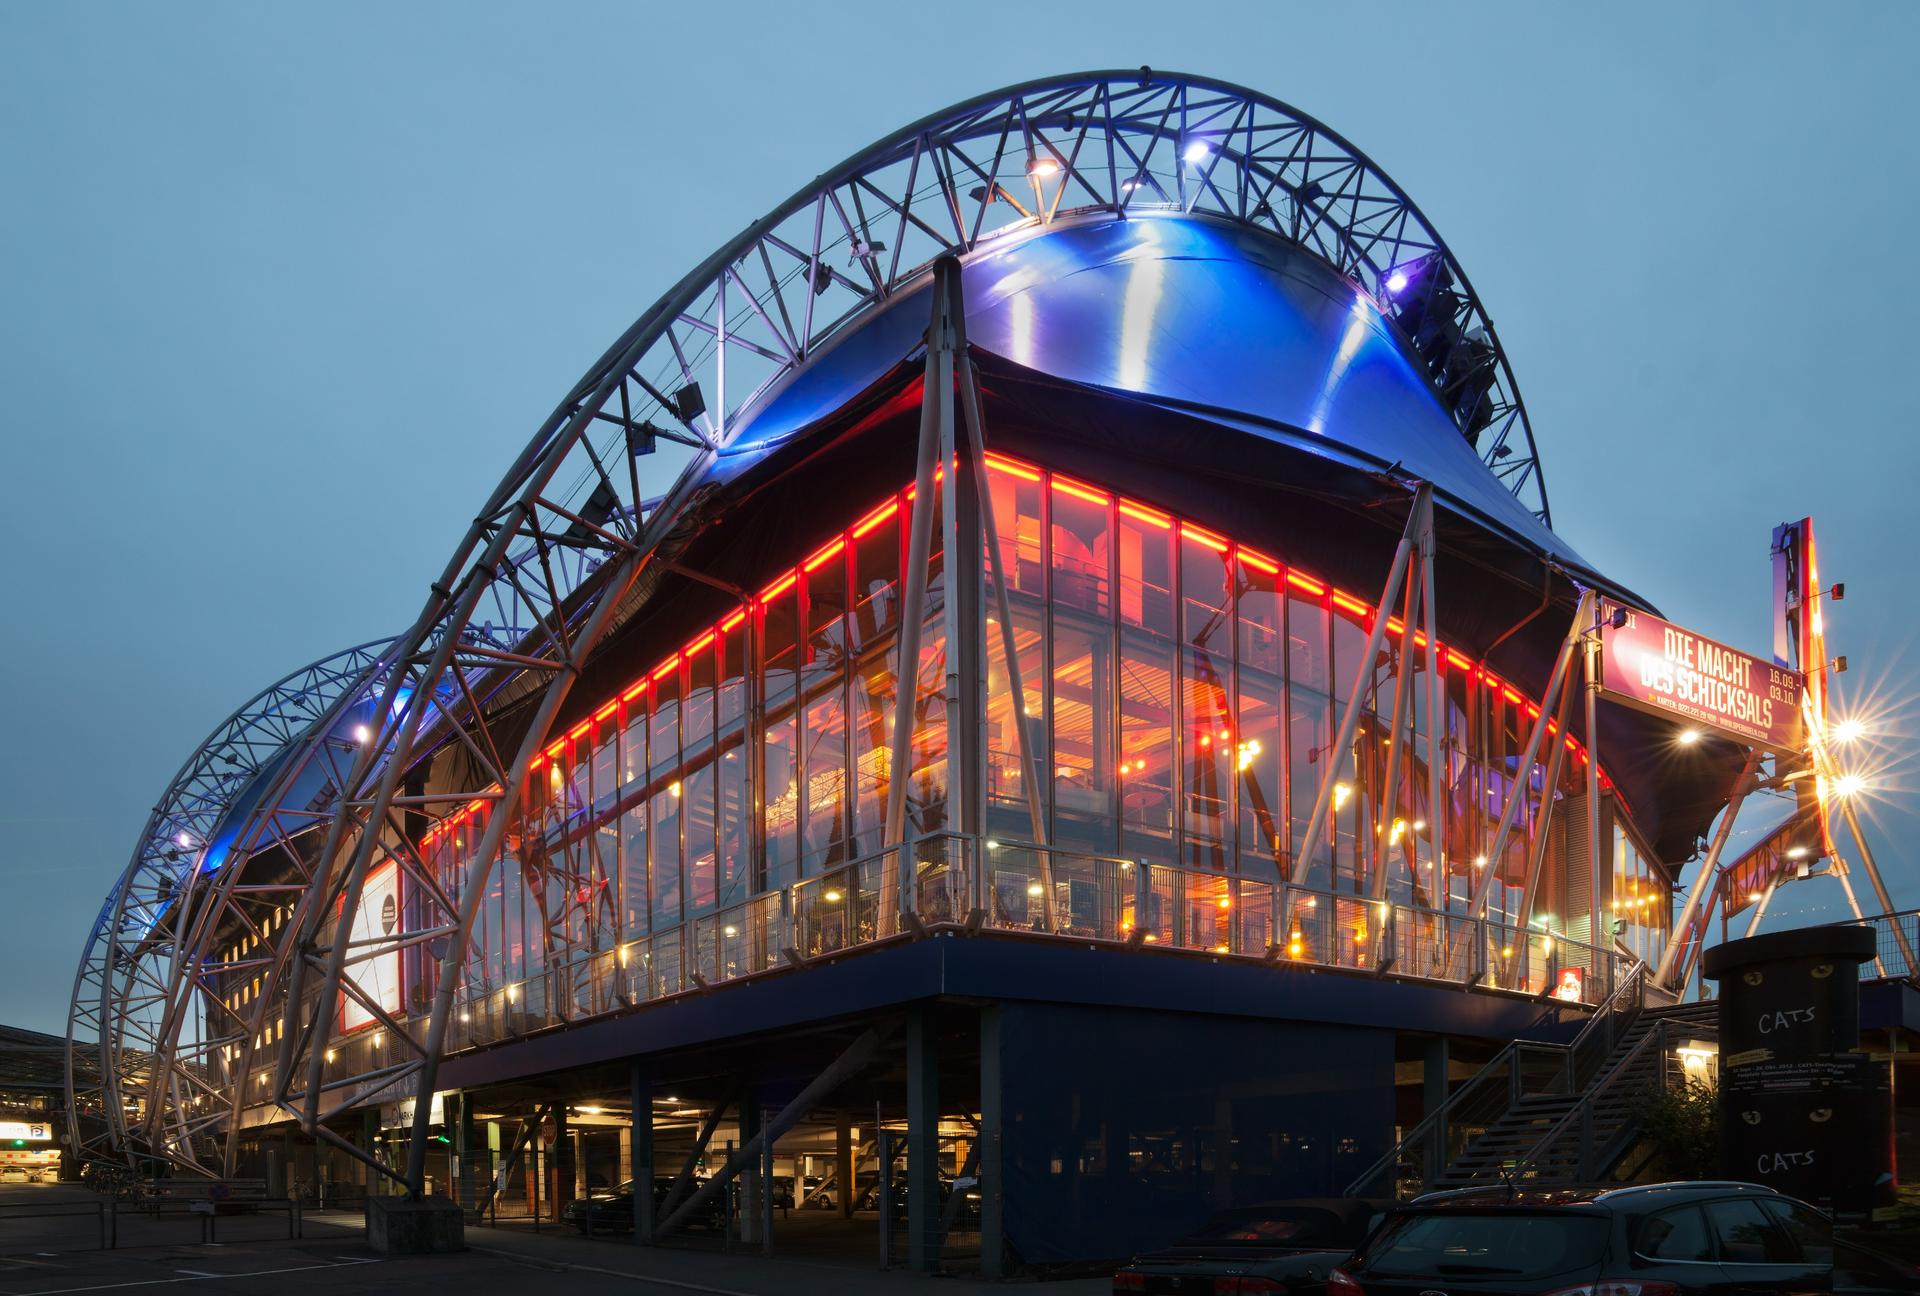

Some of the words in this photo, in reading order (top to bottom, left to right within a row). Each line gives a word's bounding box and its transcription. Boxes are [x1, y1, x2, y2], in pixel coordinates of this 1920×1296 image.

[1665, 628, 1694, 669] DIE
[1697, 640, 1752, 689] MACHT
[1640, 653, 1675, 695] DES
[1677, 667, 1773, 729] SCHICKSALS
[1769, 685, 1796, 706] 03.10.
[1758, 1006, 1816, 1034] CATS
[1757, 1149, 1815, 1175] CATS
